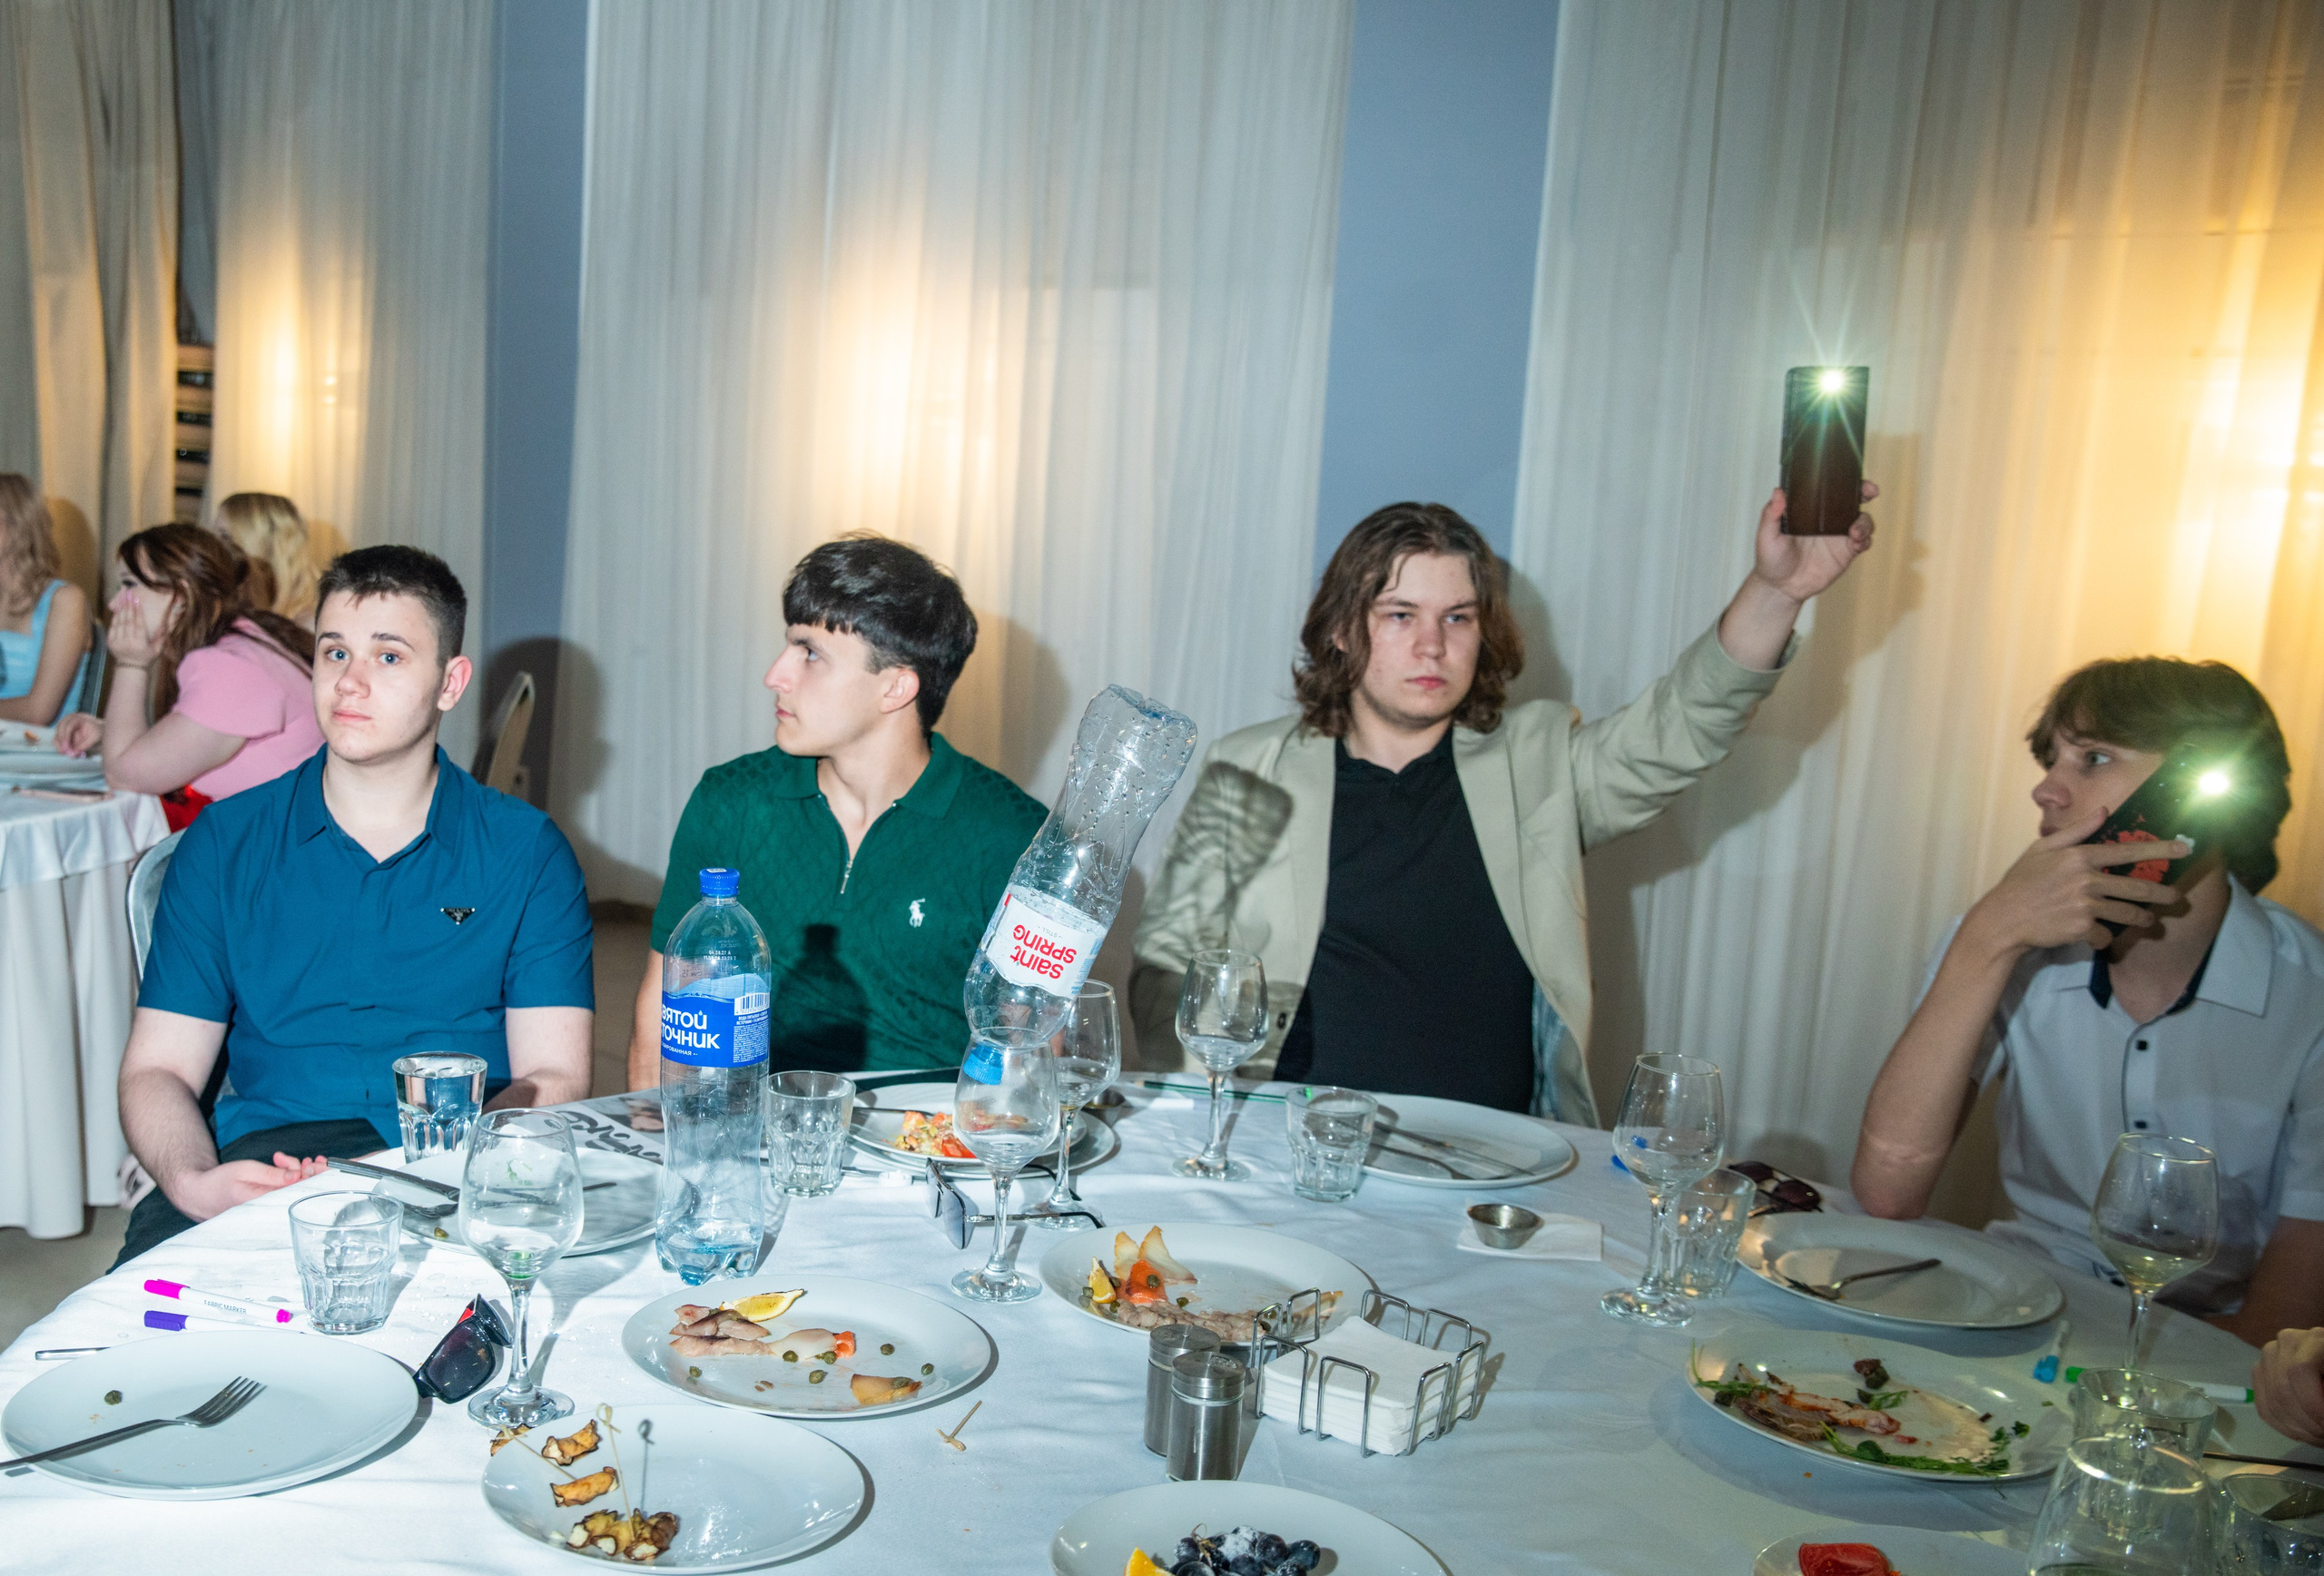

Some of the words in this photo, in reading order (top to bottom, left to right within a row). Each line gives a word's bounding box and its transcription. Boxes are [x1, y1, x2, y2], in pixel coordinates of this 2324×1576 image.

[1042, 926, 1059, 939] STILL
[1009, 945, 1064, 980] saint
[662, 1003, 707, 1030] ВЯТОЙ
[662, 1022, 721, 1049] ТОЧНИК
[203, 1299, 223, 1310] FABRIC
[223, 1304, 247, 1315] MARKER
